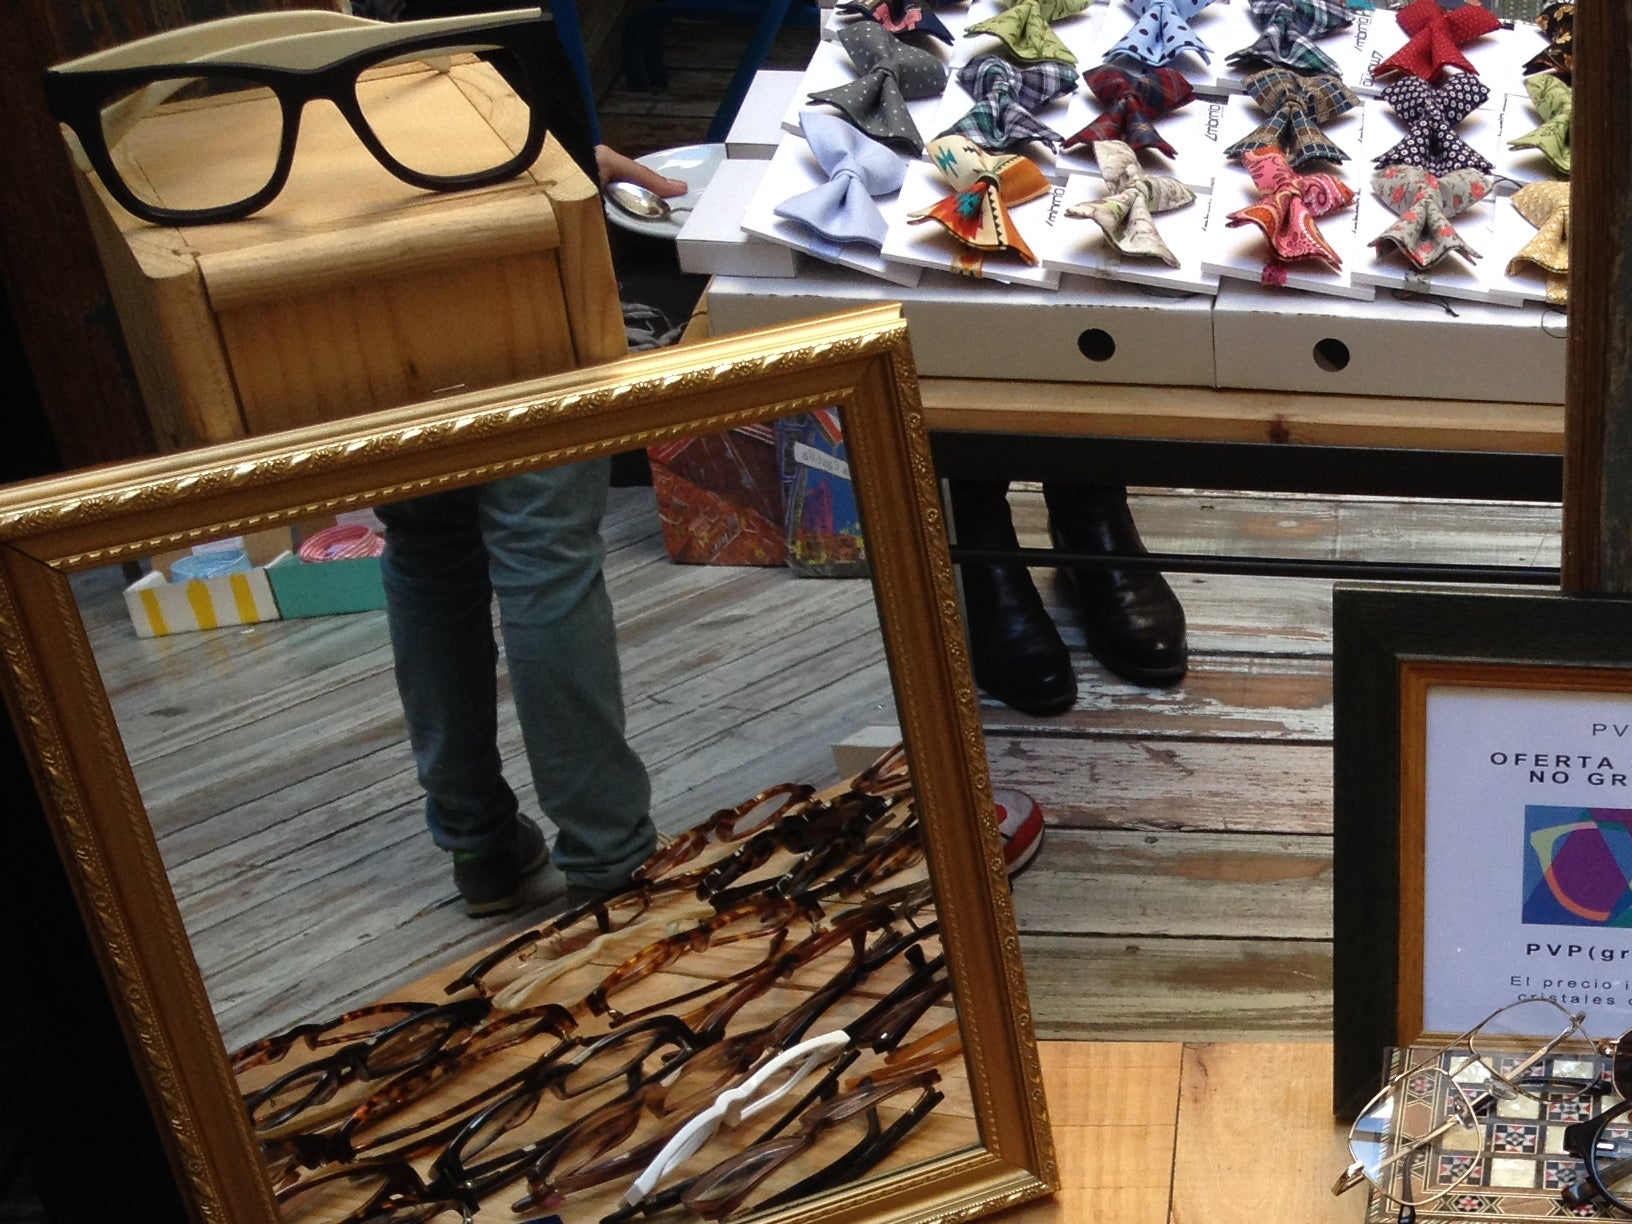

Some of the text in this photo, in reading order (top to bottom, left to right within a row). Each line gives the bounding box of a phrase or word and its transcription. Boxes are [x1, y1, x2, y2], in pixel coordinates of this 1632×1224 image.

[1490, 752, 1614, 771] OFERTA
[1529, 770, 1570, 785] NO
[1510, 976, 1531, 987] El
[1543, 976, 1612, 992] precio
[1517, 991, 1616, 1007] cristales
